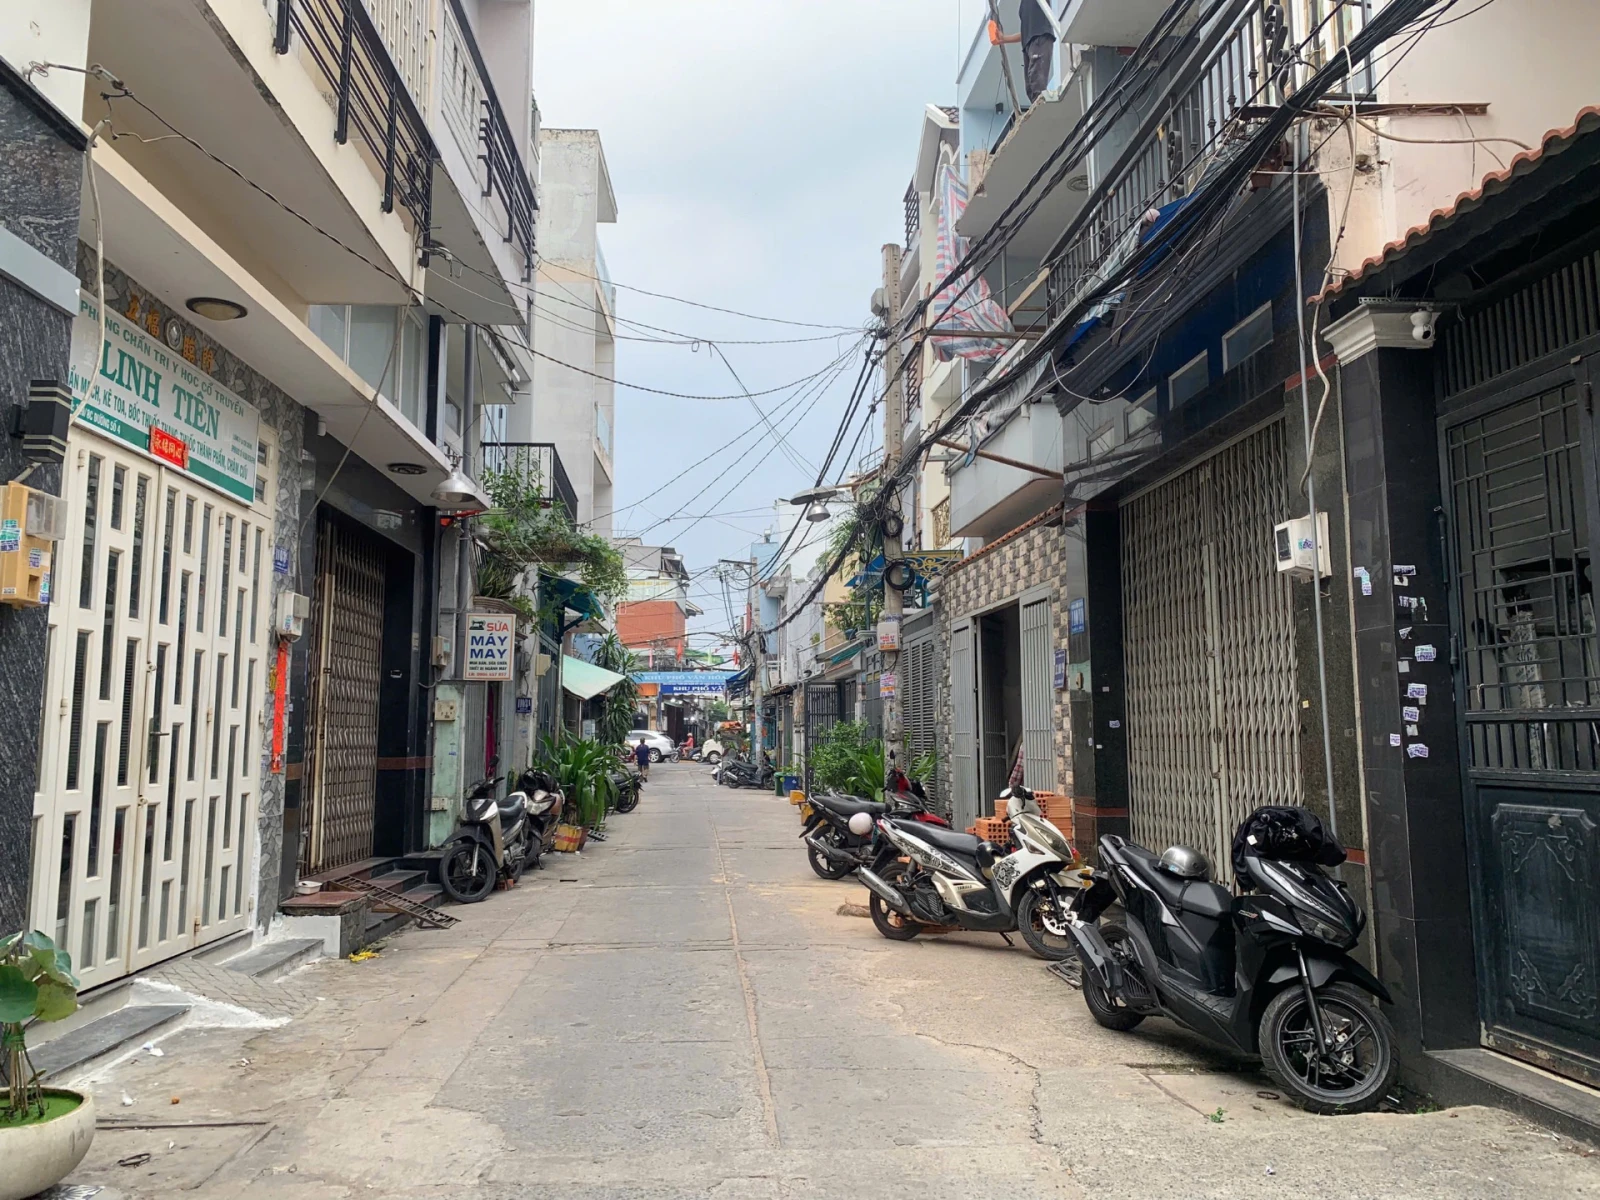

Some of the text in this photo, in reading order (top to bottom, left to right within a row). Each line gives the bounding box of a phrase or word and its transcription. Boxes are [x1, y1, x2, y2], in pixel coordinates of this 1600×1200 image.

[81, 300, 120, 336] PHNG
[154, 349, 170, 370] TRỊ
[172, 361, 179, 373] Y
[181, 367, 199, 387] HỌC
[215, 390, 244, 417] TRUYỀN
[99, 339, 220, 440] LINH TIÊN
[81, 376, 101, 407] MCH,
[114, 395, 127, 418] TOA,
[128, 401, 141, 424] BỐC
[110, 419, 116, 432] SỐ
[116, 424, 121, 435] 4
[486, 620, 509, 632] SỬA
[470, 633, 508, 646] MÁY
[470, 648, 507, 659] MAY
